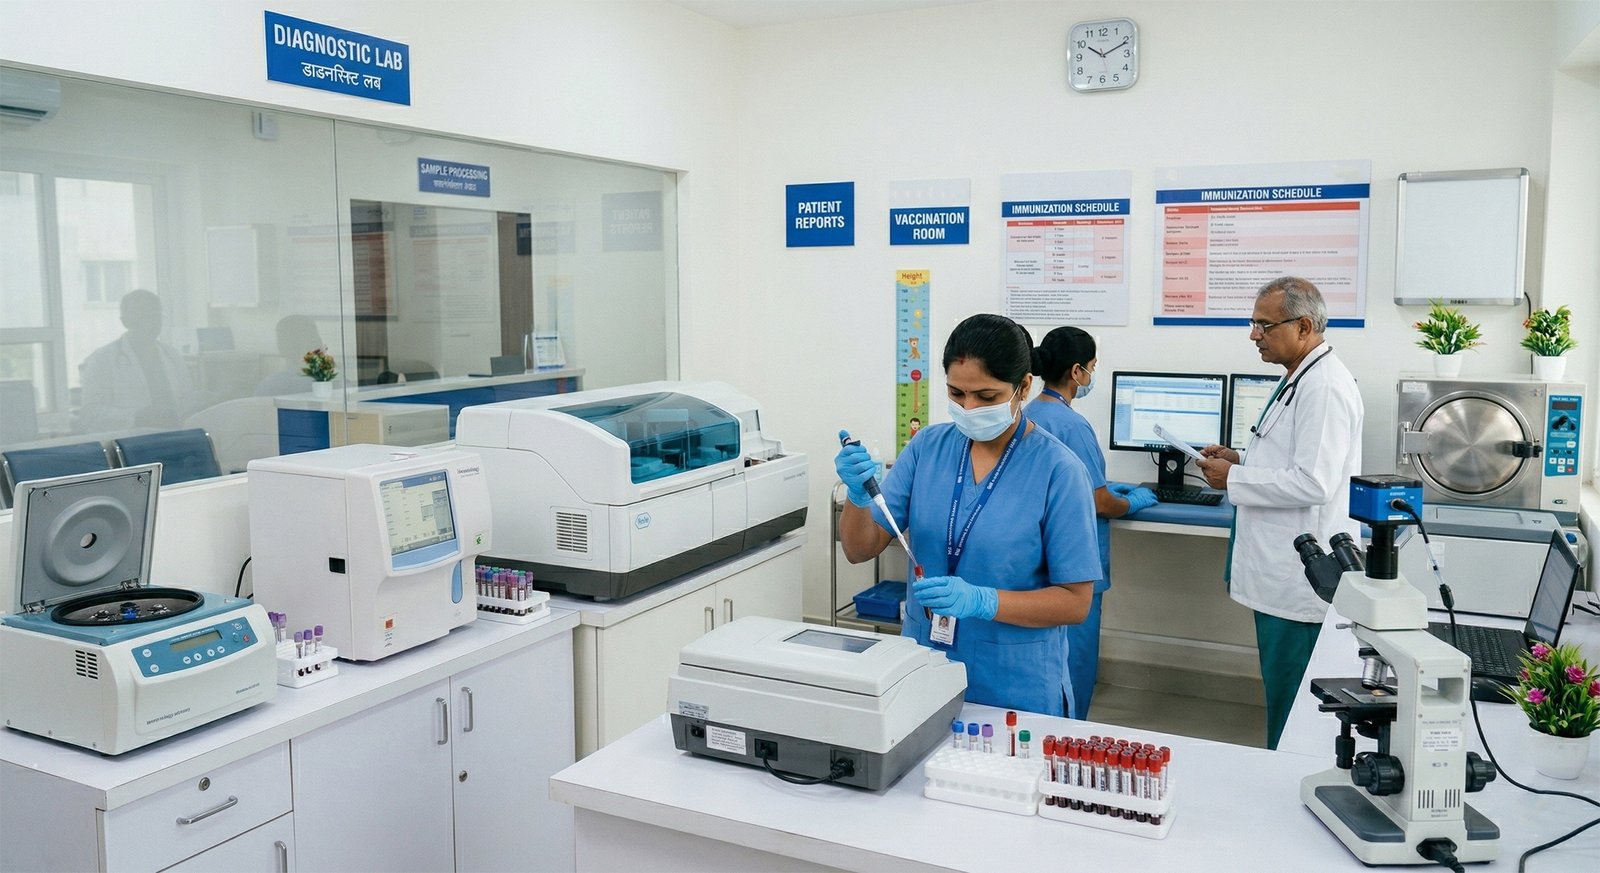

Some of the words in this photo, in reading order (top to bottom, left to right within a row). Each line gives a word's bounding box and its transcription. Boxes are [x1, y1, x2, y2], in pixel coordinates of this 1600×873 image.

[1085, 30, 1093, 38] 11
[1098, 28, 1108, 36] 12
[1077, 40, 1086, 49] 10
[1122, 36, 1129, 44] 2
[274, 24, 370, 64] DIAGNOSTIC
[376, 48, 402, 70] LAB
[1076, 53, 1083, 62] 9
[1077, 67, 1084, 75] 8
[1087, 76, 1093, 84] 7
[1099, 75, 1106, 83] 6
[1113, 73, 1119, 82] 5
[363, 75, 381, 90] लब
[420, 163, 448, 176] SAMPLE
[448, 166, 488, 181] PROCESSING
[1201, 189, 1270, 201] IMMUNIZATION
[1272, 187, 1322, 200] SCHEDULE
[798, 200, 841, 214] PATIENT
[1012, 203, 1073, 215] IMMUNIZATION
[1075, 202, 1120, 213] SCHEDULE
[796, 215, 845, 229] REPORTS
[895, 212, 965, 226] VACCINATION
[913, 228, 946, 240] ROOM
[901, 272, 923, 281] Height
